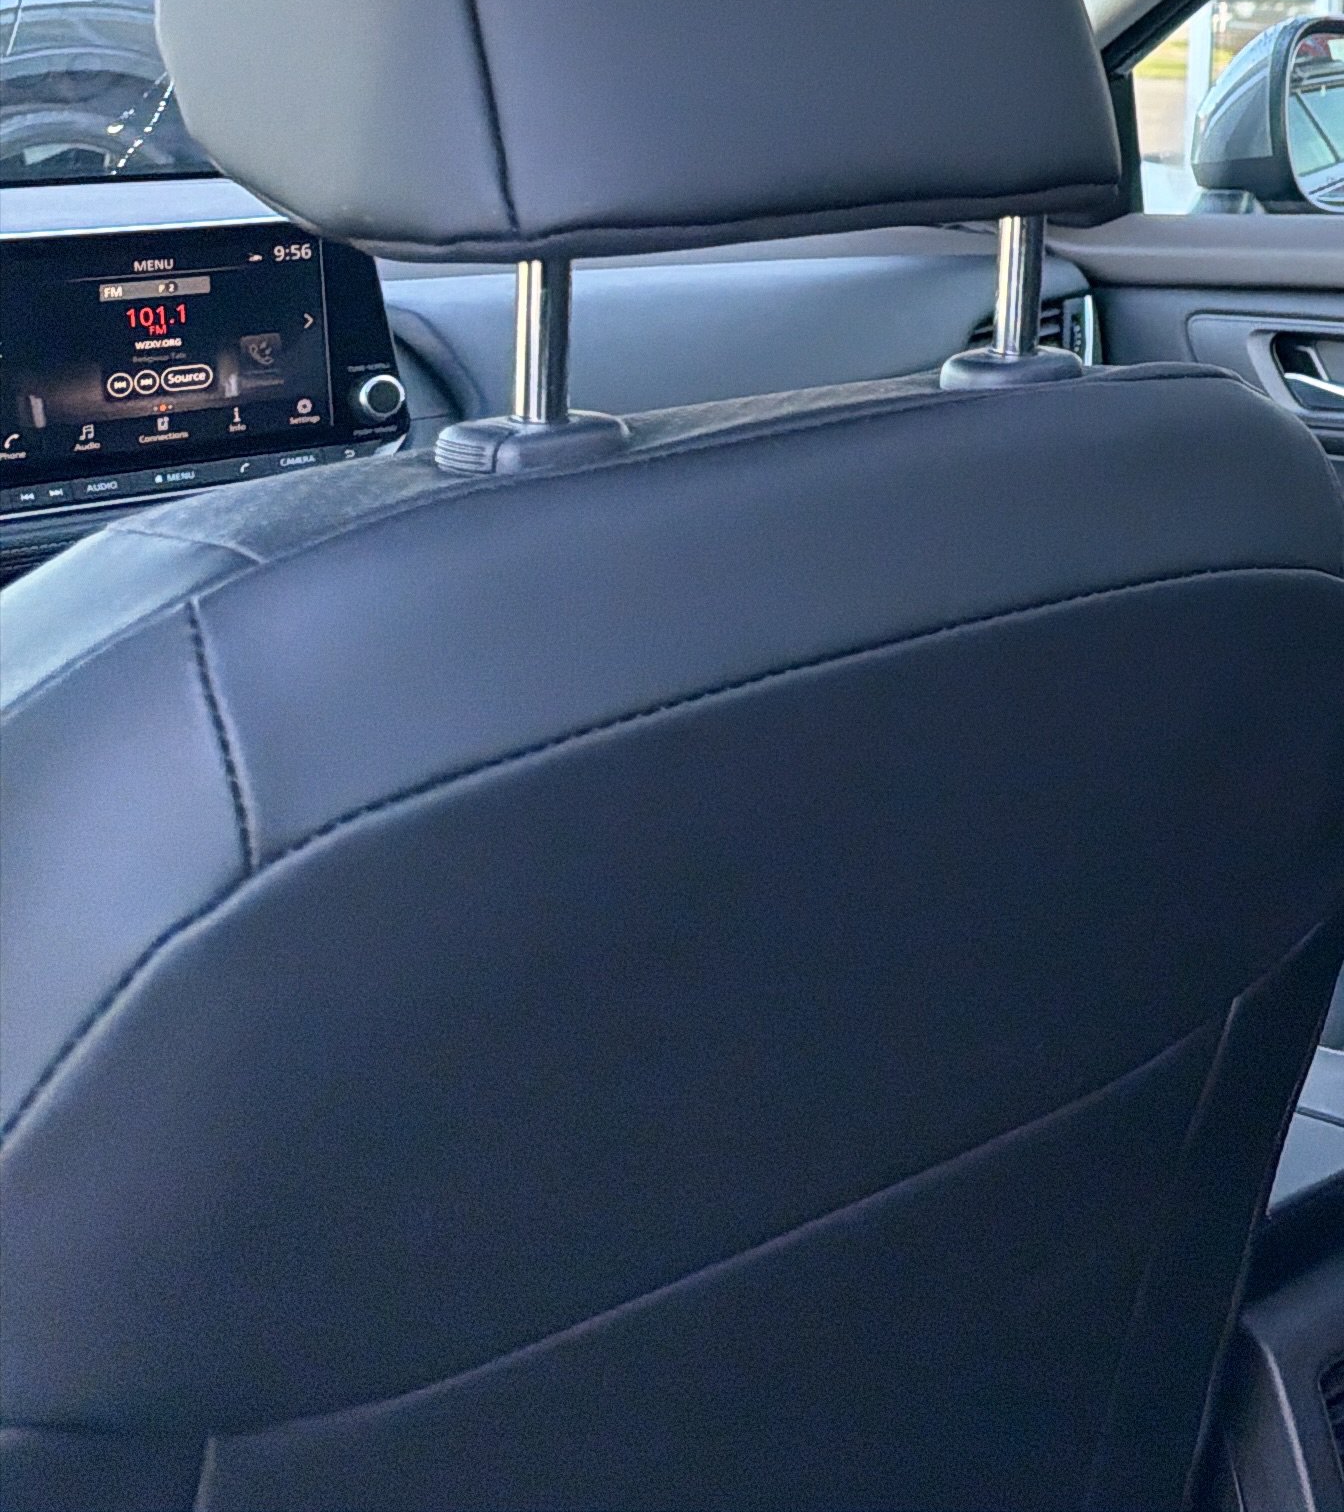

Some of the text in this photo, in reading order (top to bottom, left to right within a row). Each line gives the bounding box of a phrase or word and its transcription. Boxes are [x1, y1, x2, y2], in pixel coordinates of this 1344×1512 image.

[273, 243, 312, 262] 9:56
[133, 258, 174, 272] MENU
[103, 286, 123, 298] FM
[126, 303, 186, 328] 101.1
[149, 324, 168, 335] FM
[167, 371, 207, 385] Source
[229, 422, 247, 433] Info
[138, 430, 189, 444] Connections
[73, 441, 101, 453] Audio
[279, 454, 316, 467] CAMERA
[166, 470, 195, 483] MENU
[86, 480, 118, 493] AUDIO
